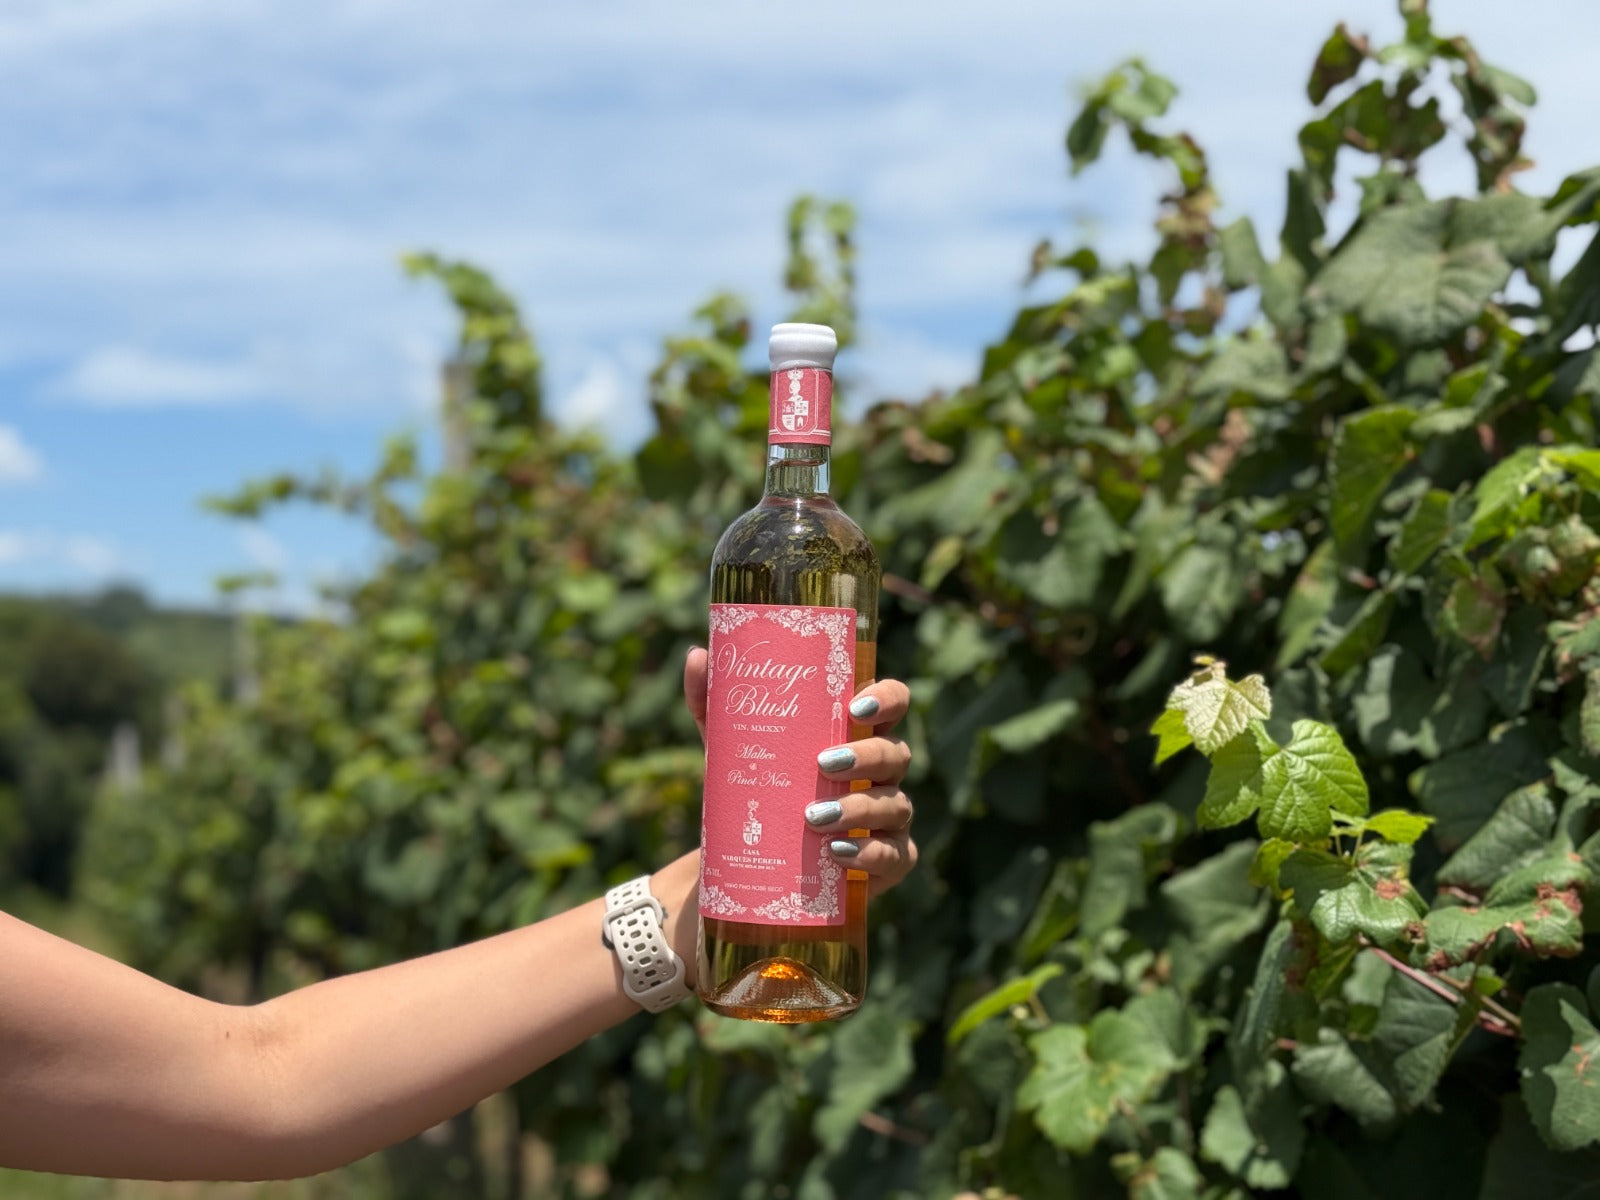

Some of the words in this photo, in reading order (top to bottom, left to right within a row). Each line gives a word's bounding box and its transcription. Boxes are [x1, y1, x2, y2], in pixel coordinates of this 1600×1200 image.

[717, 640, 818, 696] Vintage
[725, 683, 801, 718] Blush
[734, 742, 777, 760] Malbec
[727, 769, 758, 785] Pinot
[759, 770, 792, 787] Noir
[742, 848, 760, 856] CASA
[752, 857, 786, 865] PEREIRA
